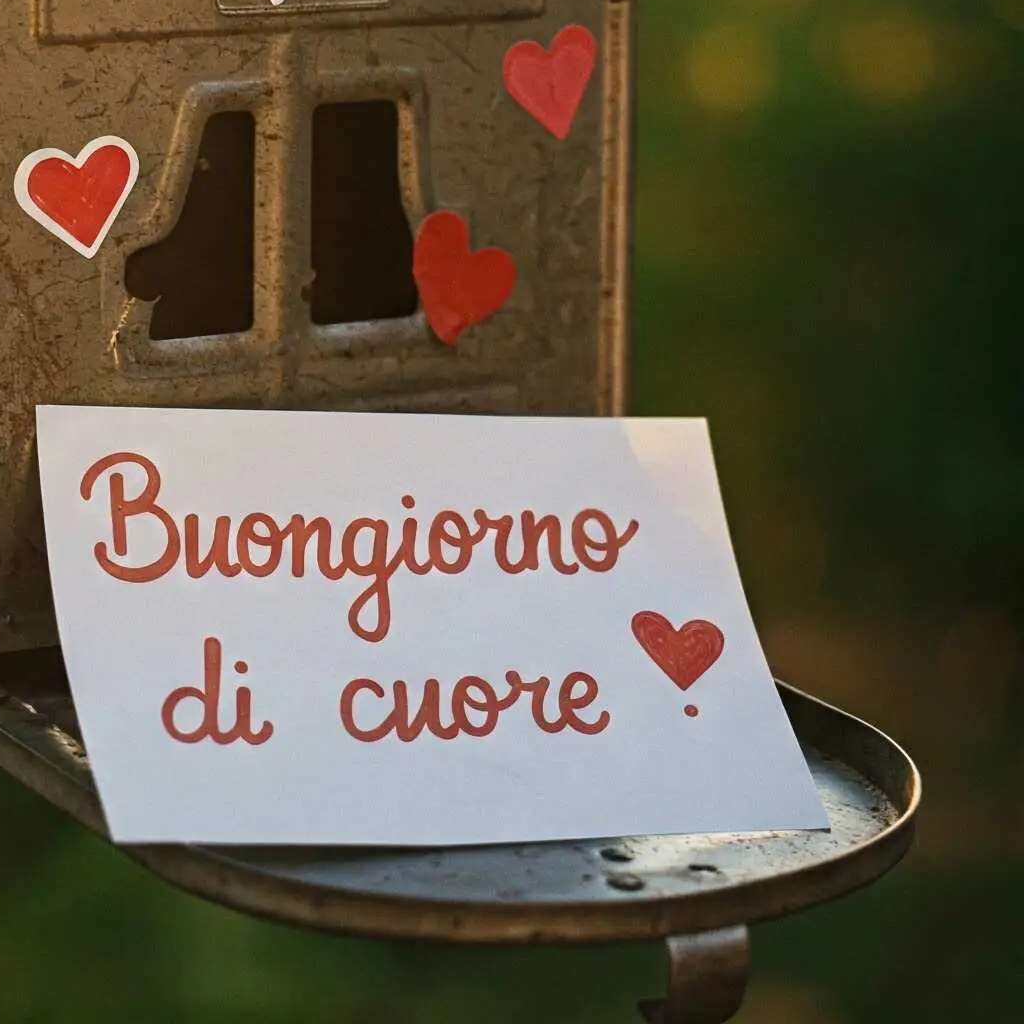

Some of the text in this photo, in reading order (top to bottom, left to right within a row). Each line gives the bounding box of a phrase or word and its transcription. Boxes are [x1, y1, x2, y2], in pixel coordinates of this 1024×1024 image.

[79, 451, 639, 643] Buongiorno
[161, 636, 610, 745] di cuore
